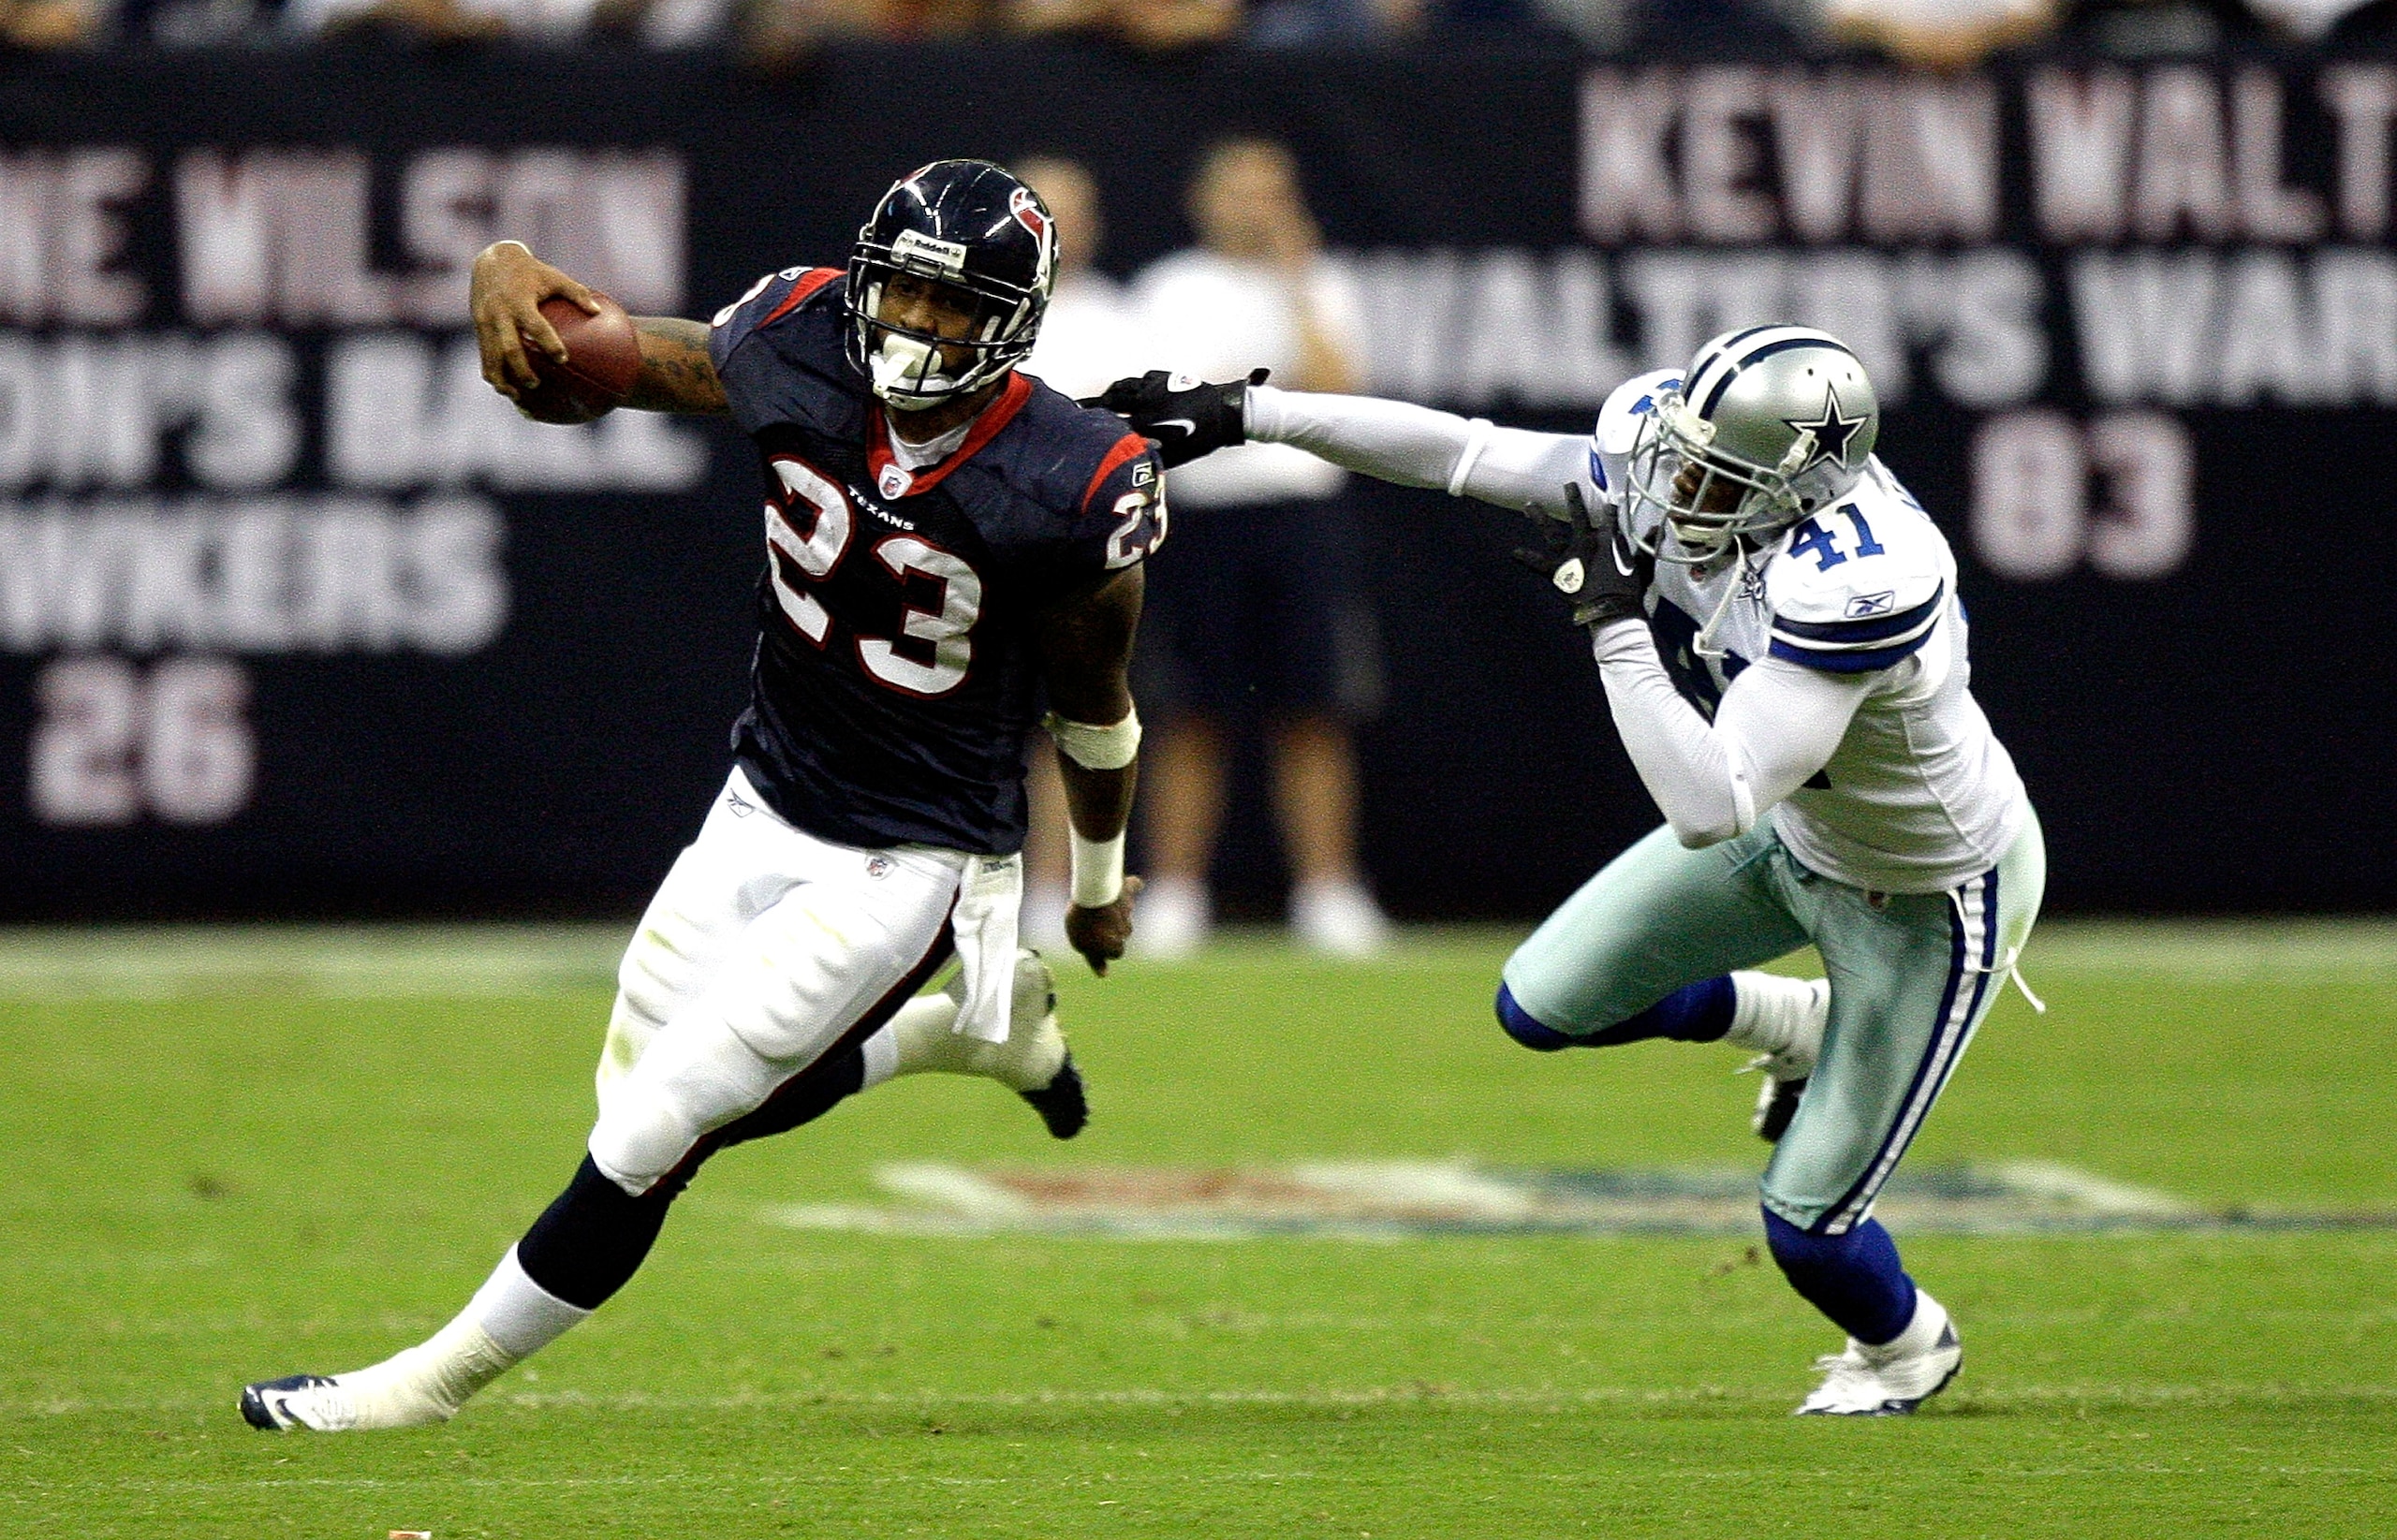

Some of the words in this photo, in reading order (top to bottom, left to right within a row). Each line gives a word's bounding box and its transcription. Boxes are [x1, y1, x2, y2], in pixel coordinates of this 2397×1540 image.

[174, 145, 688, 326] WILSON
[1577, 62, 2002, 243] KEVIN
[2024, 62, 2397, 243] WALT
[763, 457, 984, 697] 23
[847, 484, 915, 531] TEXANS
[1787, 502, 1886, 573] 41
[1968, 407, 2196, 580] 83
[30, 655, 257, 826] 26
